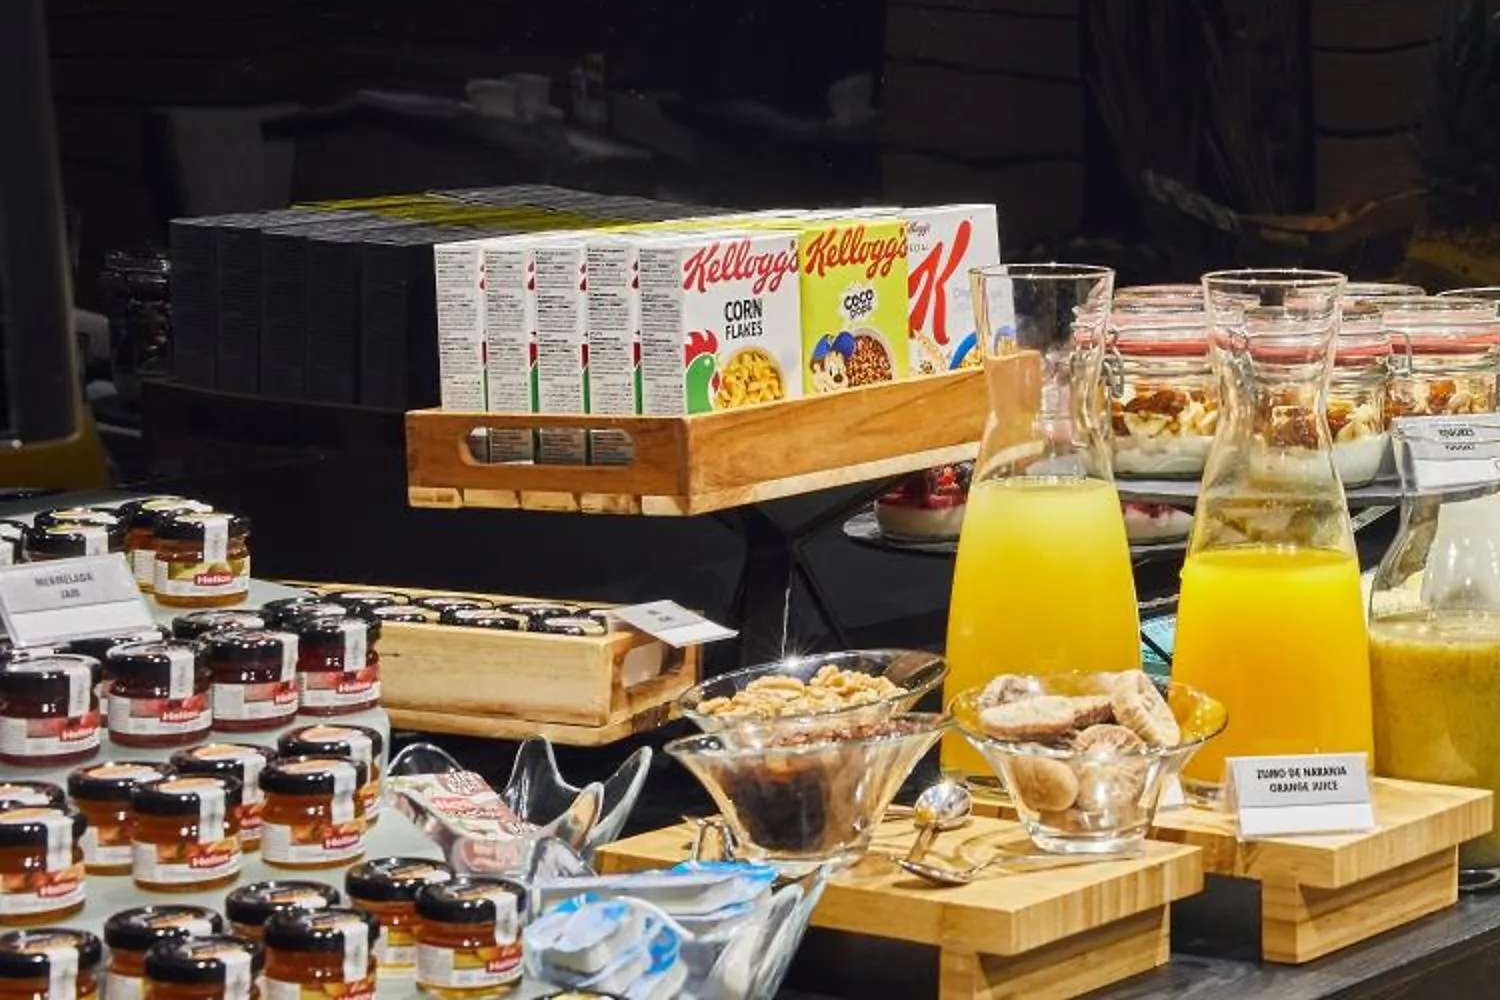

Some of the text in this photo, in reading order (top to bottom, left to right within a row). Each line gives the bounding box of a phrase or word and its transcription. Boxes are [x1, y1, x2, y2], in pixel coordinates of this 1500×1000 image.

[683, 239, 799, 294] Kellogg's
[804, 225, 907, 279] Kellogg's
[908, 220, 971, 345] K
[725, 298, 763, 322] CORN
[725, 320, 763, 340] FLAKES
[1288, 768, 1300, 778] DE
